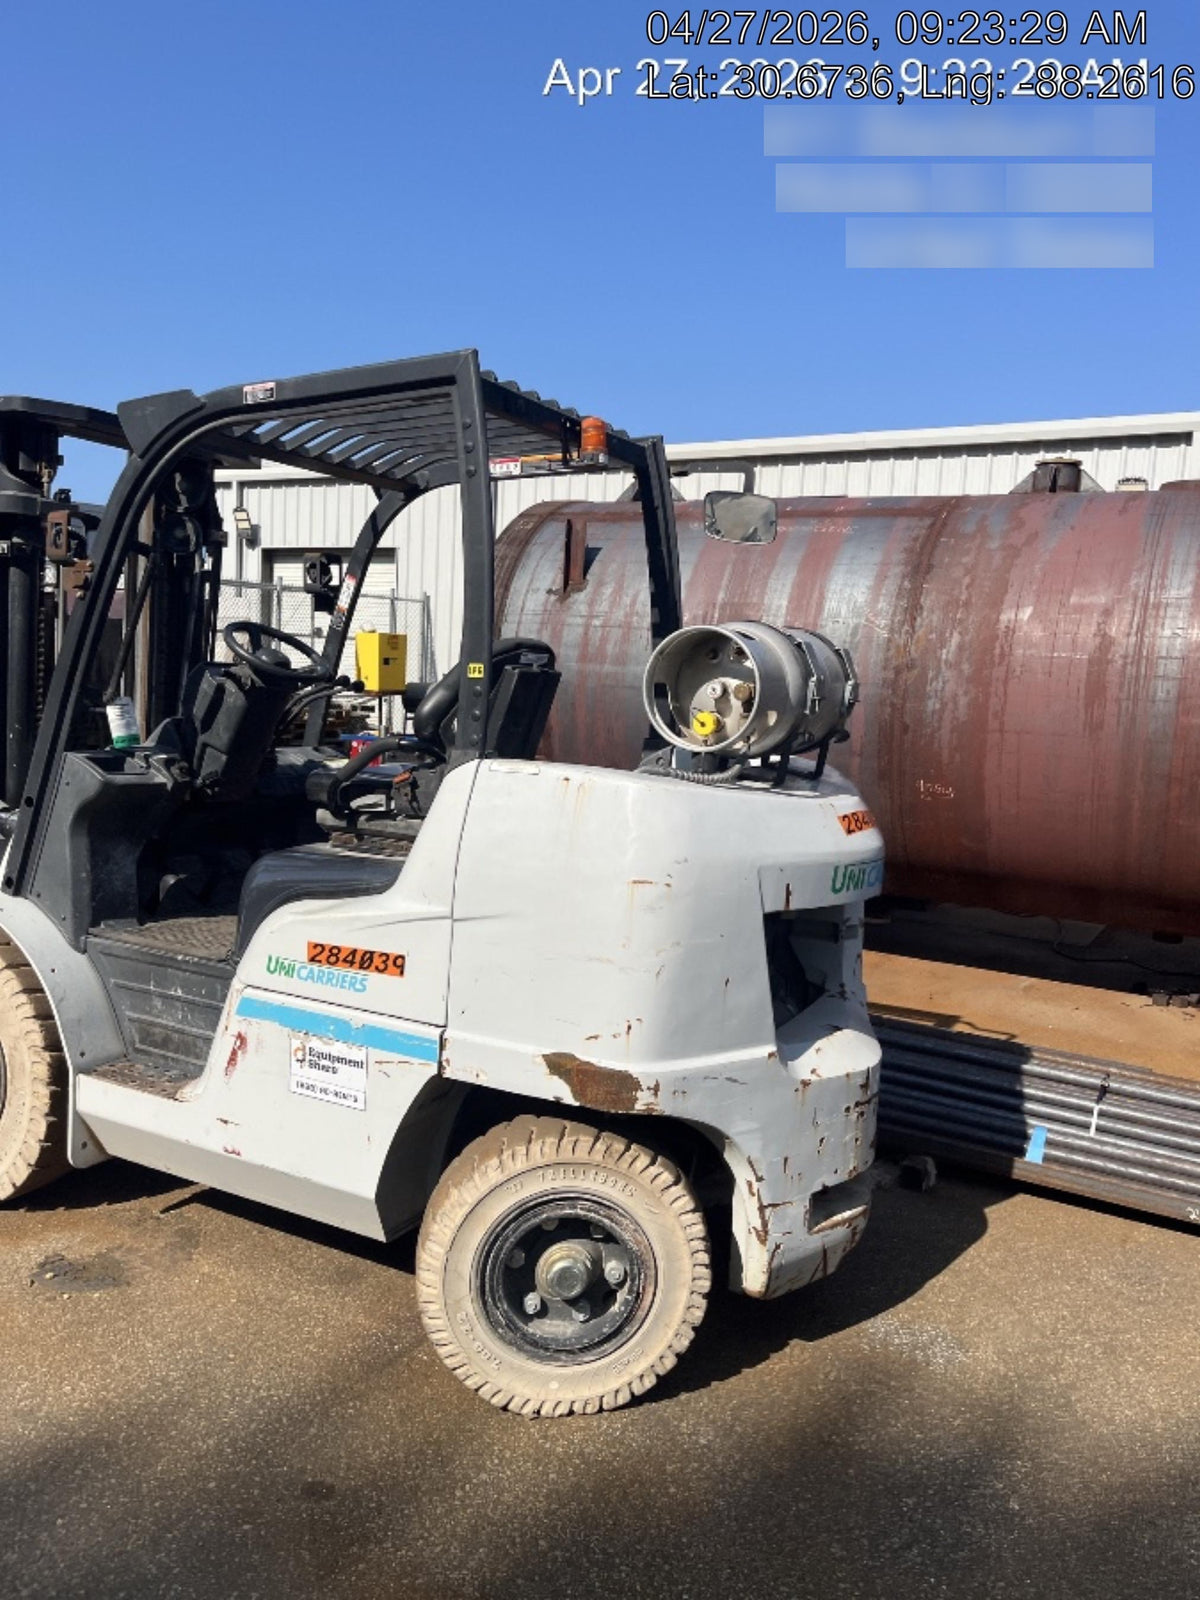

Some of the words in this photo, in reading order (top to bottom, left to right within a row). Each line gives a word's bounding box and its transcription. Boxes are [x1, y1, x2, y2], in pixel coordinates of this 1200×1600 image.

[842, 811, 874, 835] 284
[308, 942, 405, 976] 284039
[308, 1046, 365, 1070] Equipment
